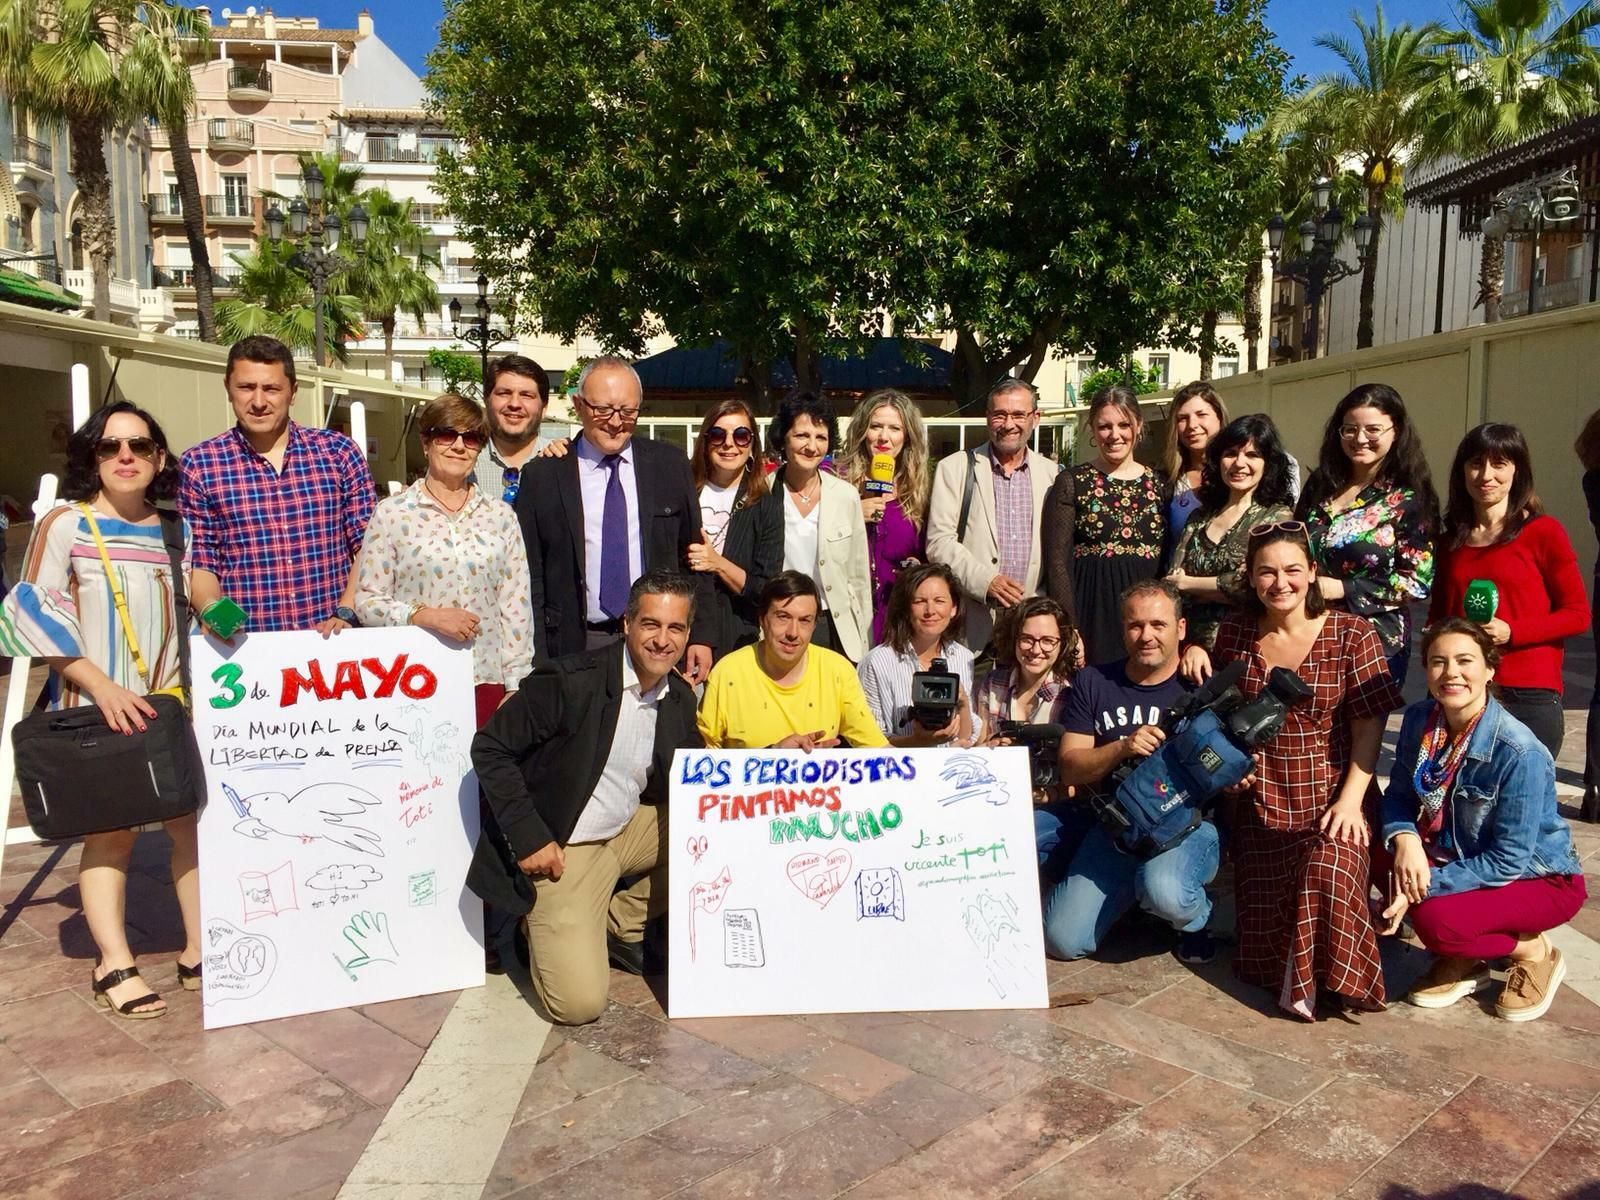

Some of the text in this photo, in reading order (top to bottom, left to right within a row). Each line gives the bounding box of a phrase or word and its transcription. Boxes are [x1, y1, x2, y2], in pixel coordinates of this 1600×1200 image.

[209, 652, 438, 710] 3 de MAYO
[249, 718, 341, 741] MUNDIAL
[352, 718, 366, 732] de
[209, 746, 309, 767] LIBERTAD
[681, 753, 917, 789] LOS PERIODISTAS
[697, 785, 842, 824] PINTAMOS
[768, 801, 904, 845] MUCHO
[911, 828, 964, 849] Je suis
